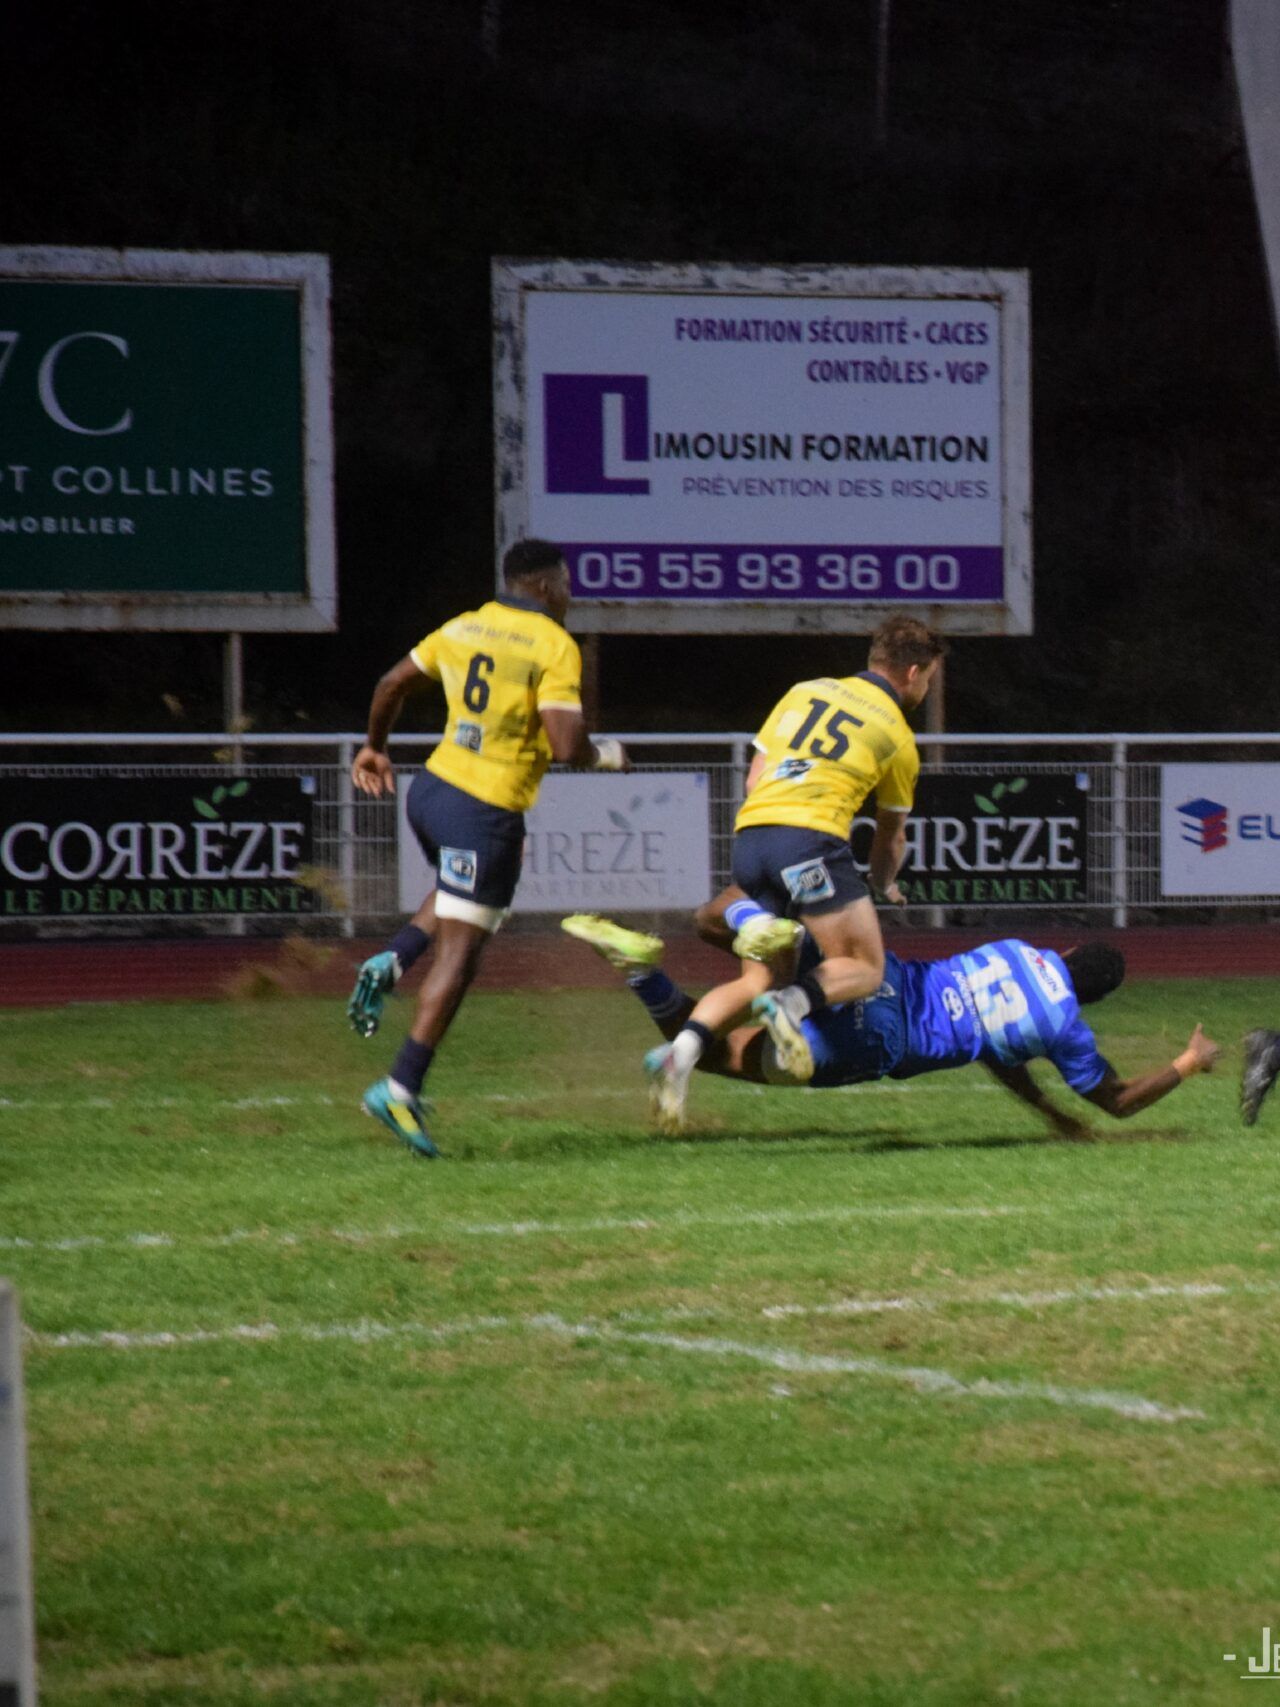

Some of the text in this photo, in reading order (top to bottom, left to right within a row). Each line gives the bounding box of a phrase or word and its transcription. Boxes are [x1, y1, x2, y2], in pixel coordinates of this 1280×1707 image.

[675, 315, 989, 345] FORMATION SÉCURITÉ CACES
[807, 355, 989, 384] CONTRÔLES VGP
[803, 434, 989, 463] FORMATION
[52, 465, 275, 498] COLLINES
[682, 473, 989, 502] PRÉVENTION DES RISQUES
[577, 551, 961, 592] 05 55 93 36 00
[463, 652, 495, 714] 6
[788, 697, 864, 761] 15
[4, 887, 44, 914] LE
